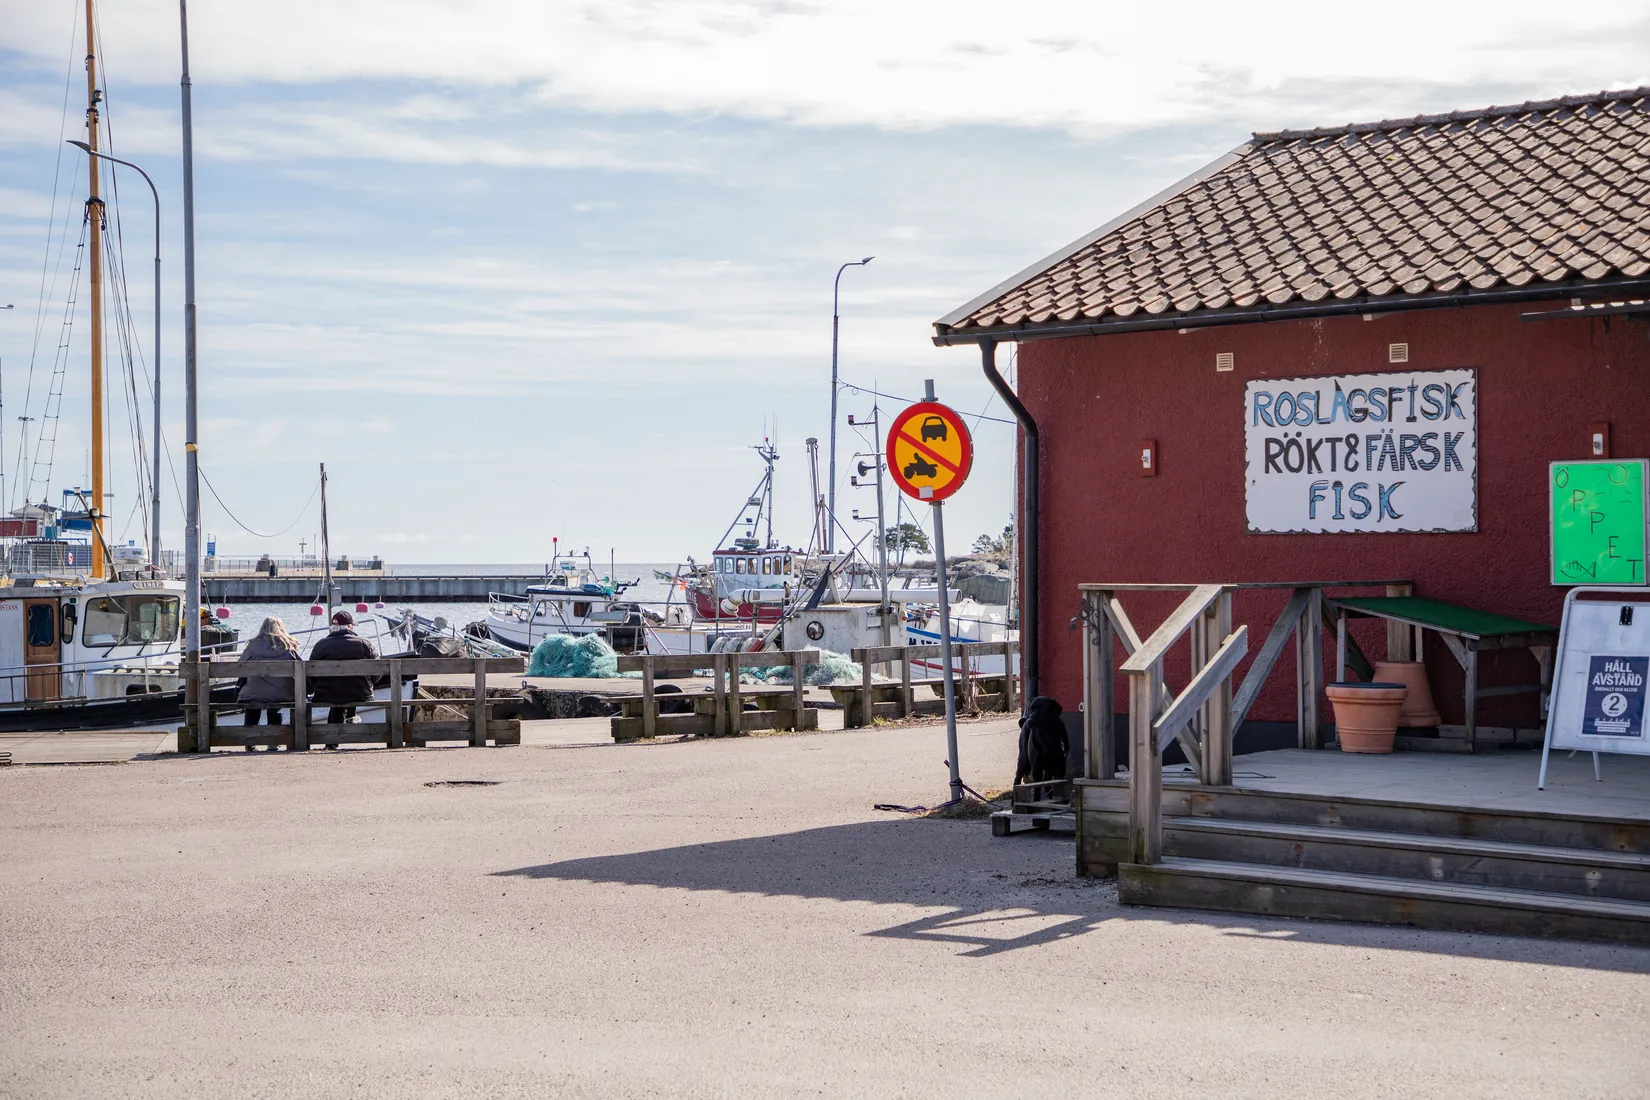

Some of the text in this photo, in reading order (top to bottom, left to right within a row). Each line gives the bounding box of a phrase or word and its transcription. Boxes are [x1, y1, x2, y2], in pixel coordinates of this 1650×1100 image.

[1253, 378, 1470, 427] ROSLAGSFISK
[1309, 479, 1406, 522] FISK
[1605, 660, 1632, 672] HÅLL
[1592, 673, 1642, 686] AVSTÅND
[1609, 696, 1620, 711] 2
